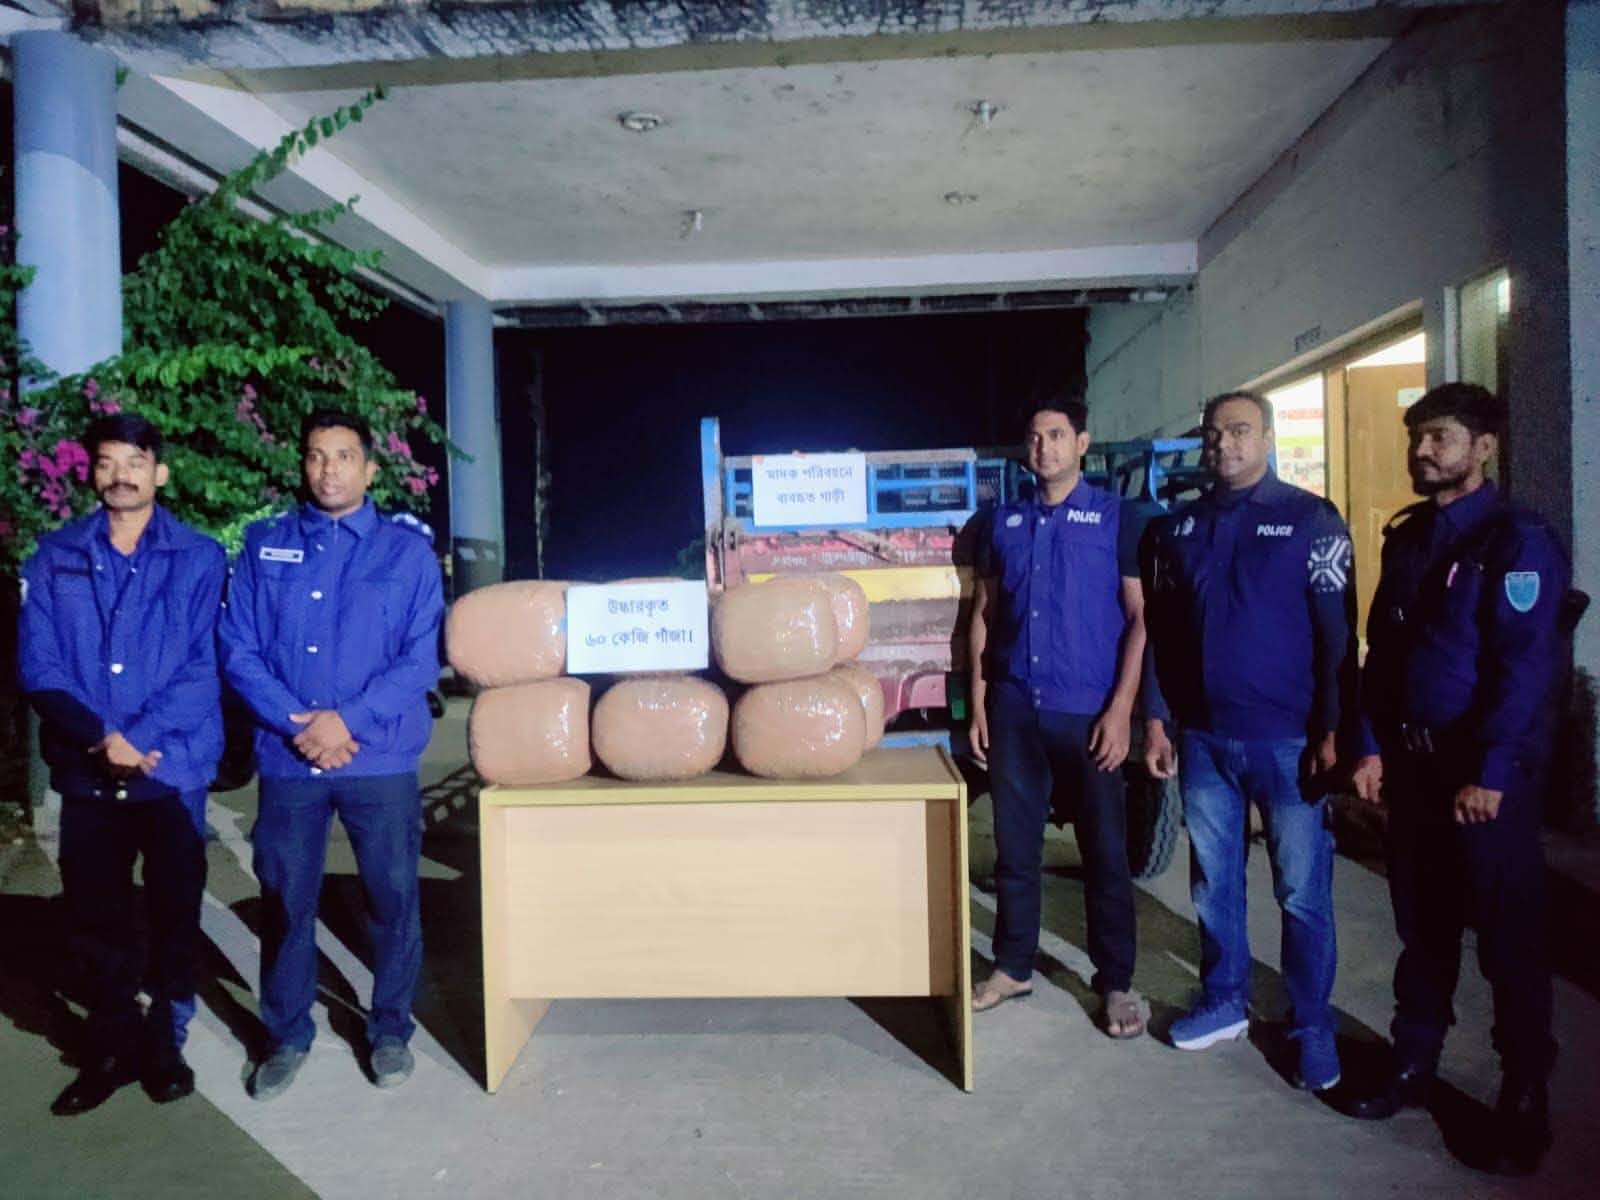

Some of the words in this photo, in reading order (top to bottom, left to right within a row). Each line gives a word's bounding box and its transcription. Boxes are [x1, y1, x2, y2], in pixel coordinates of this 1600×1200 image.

[1067, 509, 1101, 524] POLICE
[1257, 524, 1294, 537] POLICE
[608, 598, 669, 616] উদ্ধারকৃত
[585, 633, 606, 647] ৬০
[612, 627, 649, 646] কেজি
